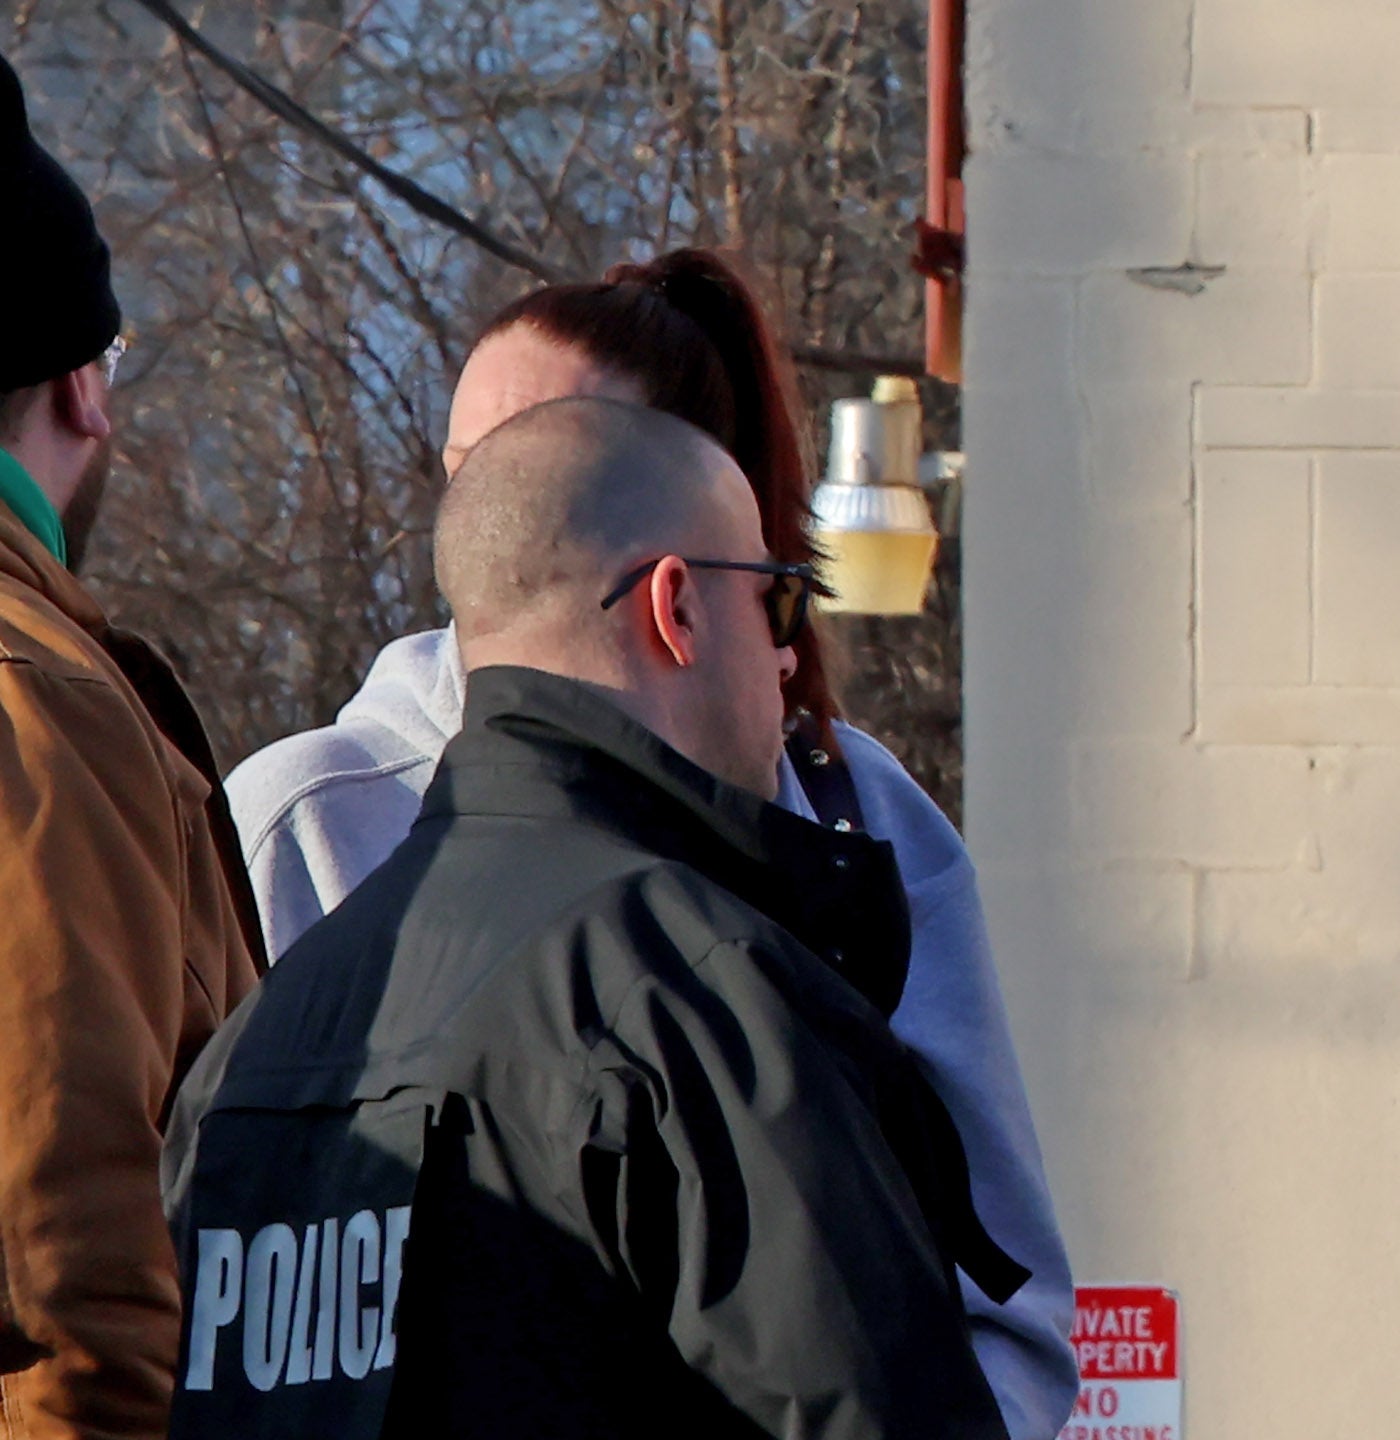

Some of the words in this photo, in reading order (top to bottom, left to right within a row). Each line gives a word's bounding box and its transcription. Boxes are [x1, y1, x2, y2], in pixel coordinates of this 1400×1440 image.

[1075, 1306, 1152, 1337] IVATE
[1077, 1340, 1168, 1373] PERTY
[1072, 1387, 1119, 1418] NO
